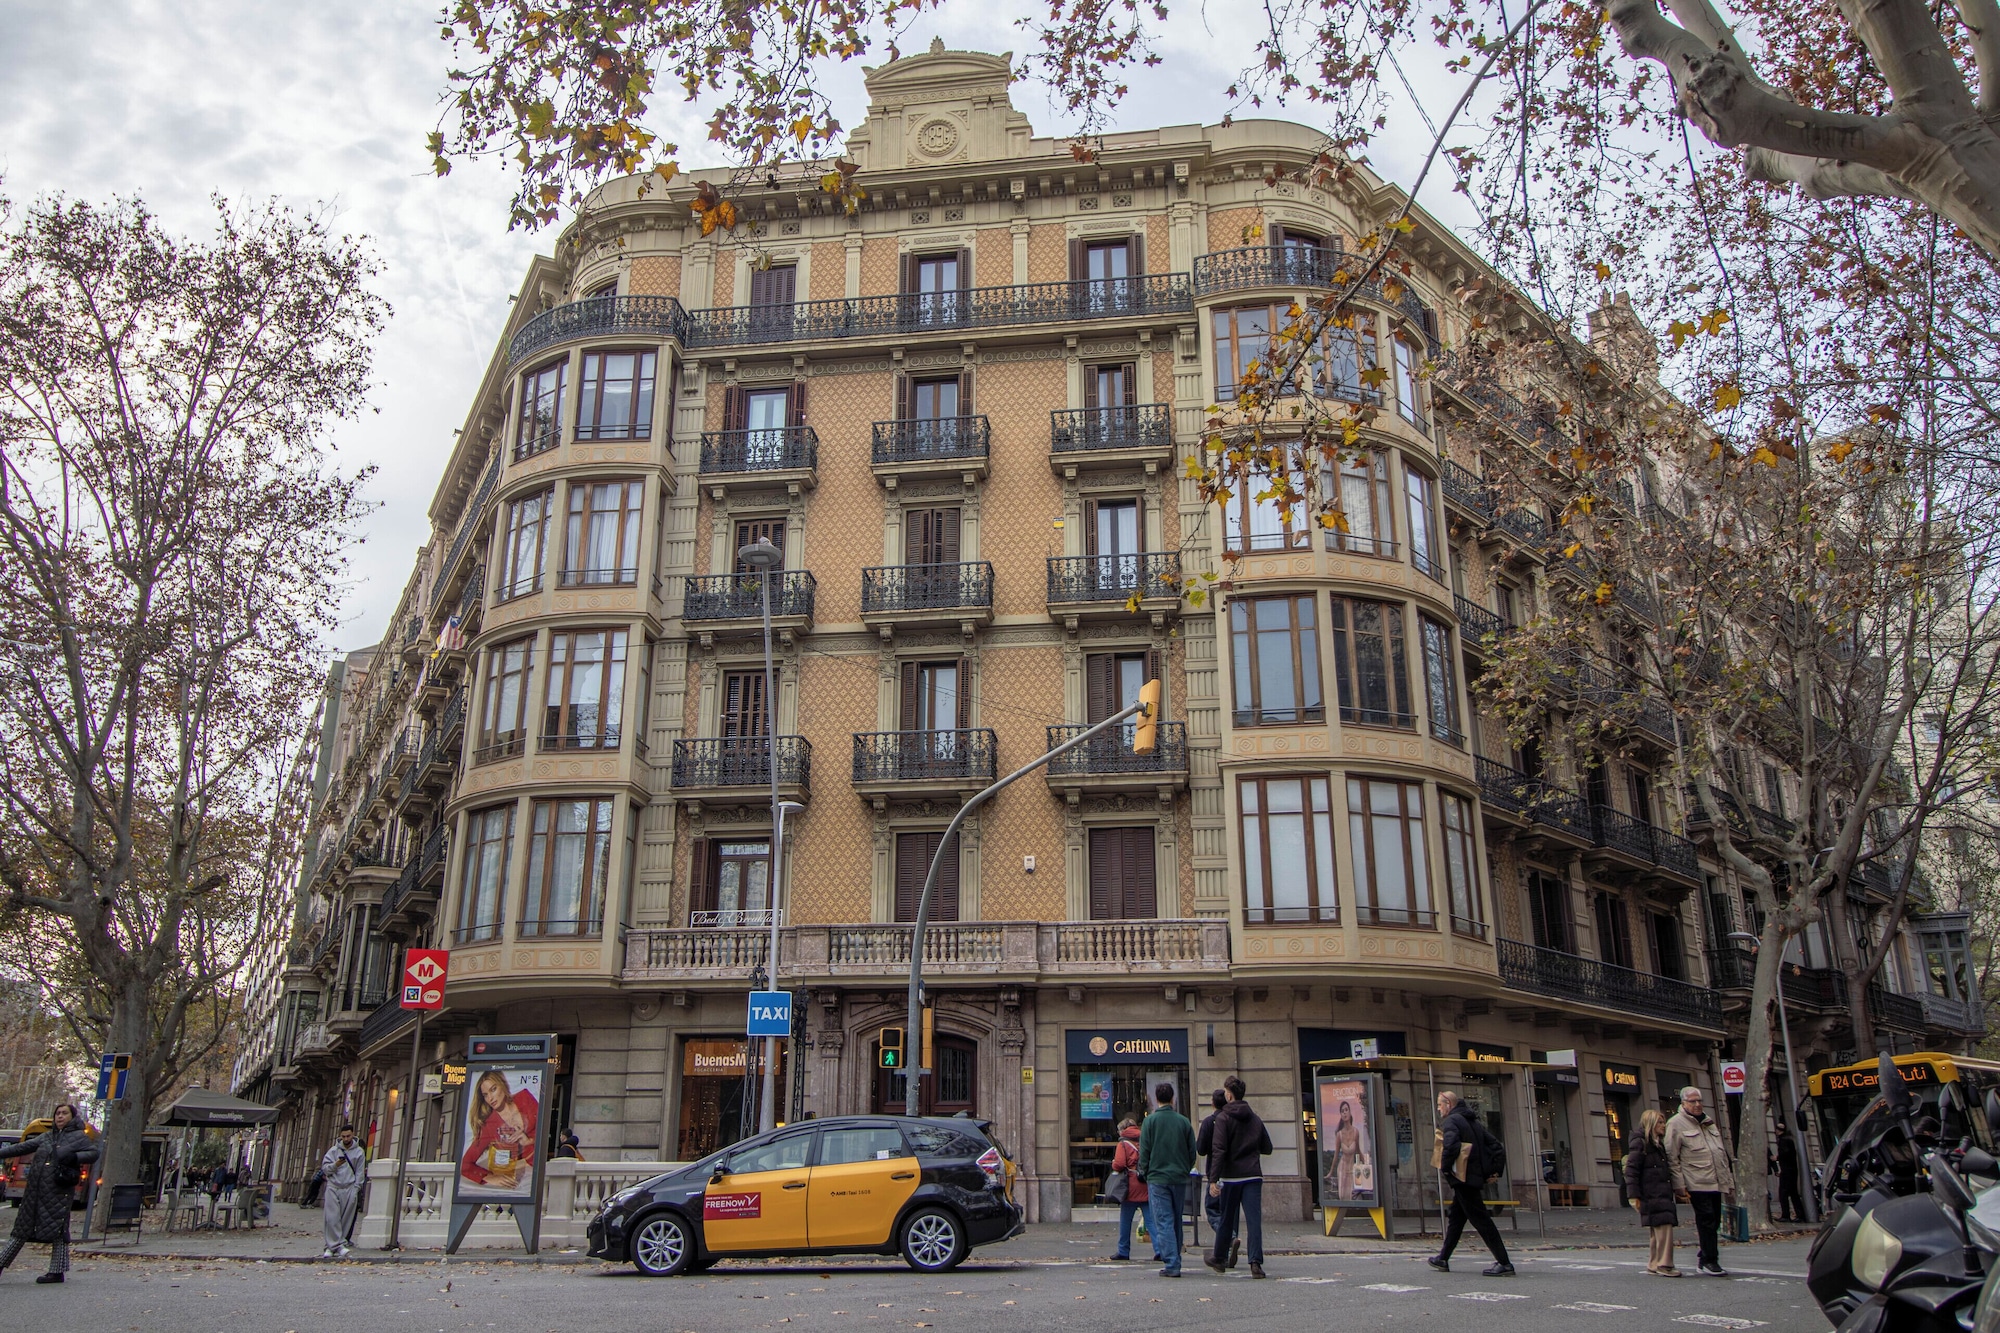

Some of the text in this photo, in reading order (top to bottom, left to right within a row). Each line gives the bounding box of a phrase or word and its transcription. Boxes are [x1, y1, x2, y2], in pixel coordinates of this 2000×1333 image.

[692, 912, 719, 924] Bed
[728, 911, 781, 926] Breakfa
[417, 963, 435, 978] M
[752, 1006, 789, 1020] TAXI
[507, 1043, 540, 1052] Urquinaona
[1113, 1039, 1171, 1054] CAFÉLUNYA
[1829, 1074, 1849, 1090] B24
[1898, 1066, 1927, 1081] uti
[705, 1199, 746, 1209] FREENOW
